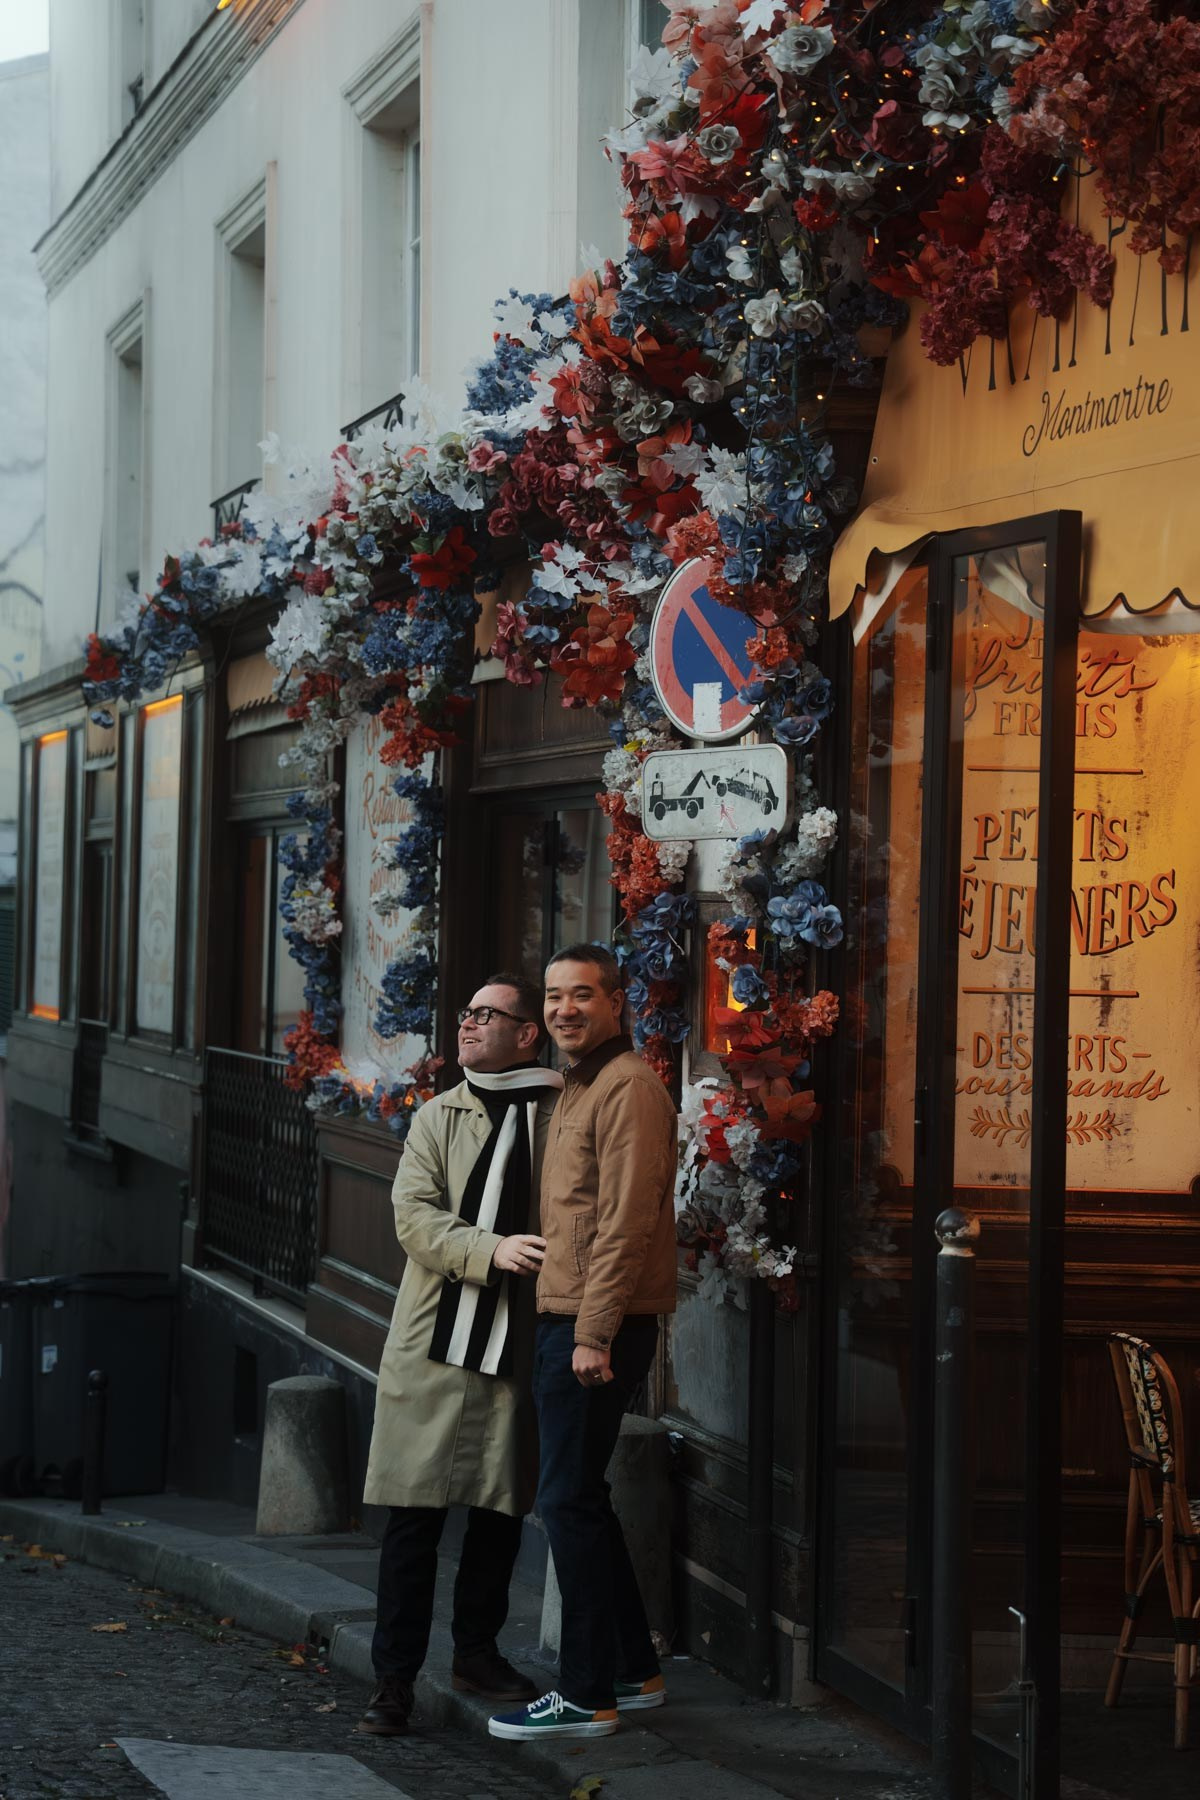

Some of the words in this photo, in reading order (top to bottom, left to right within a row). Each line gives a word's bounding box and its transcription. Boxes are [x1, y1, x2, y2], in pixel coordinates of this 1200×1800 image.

[1022, 375, 1173, 457] Montmartre
[992, 701, 1117, 739] FRIS
[973, 806, 1129, 862] PETS
[958, 864, 1178, 960] ÉJENERS
[972, 1031, 1128, 1073] DESRTS
[954, 1069, 1171, 1101] ourands
